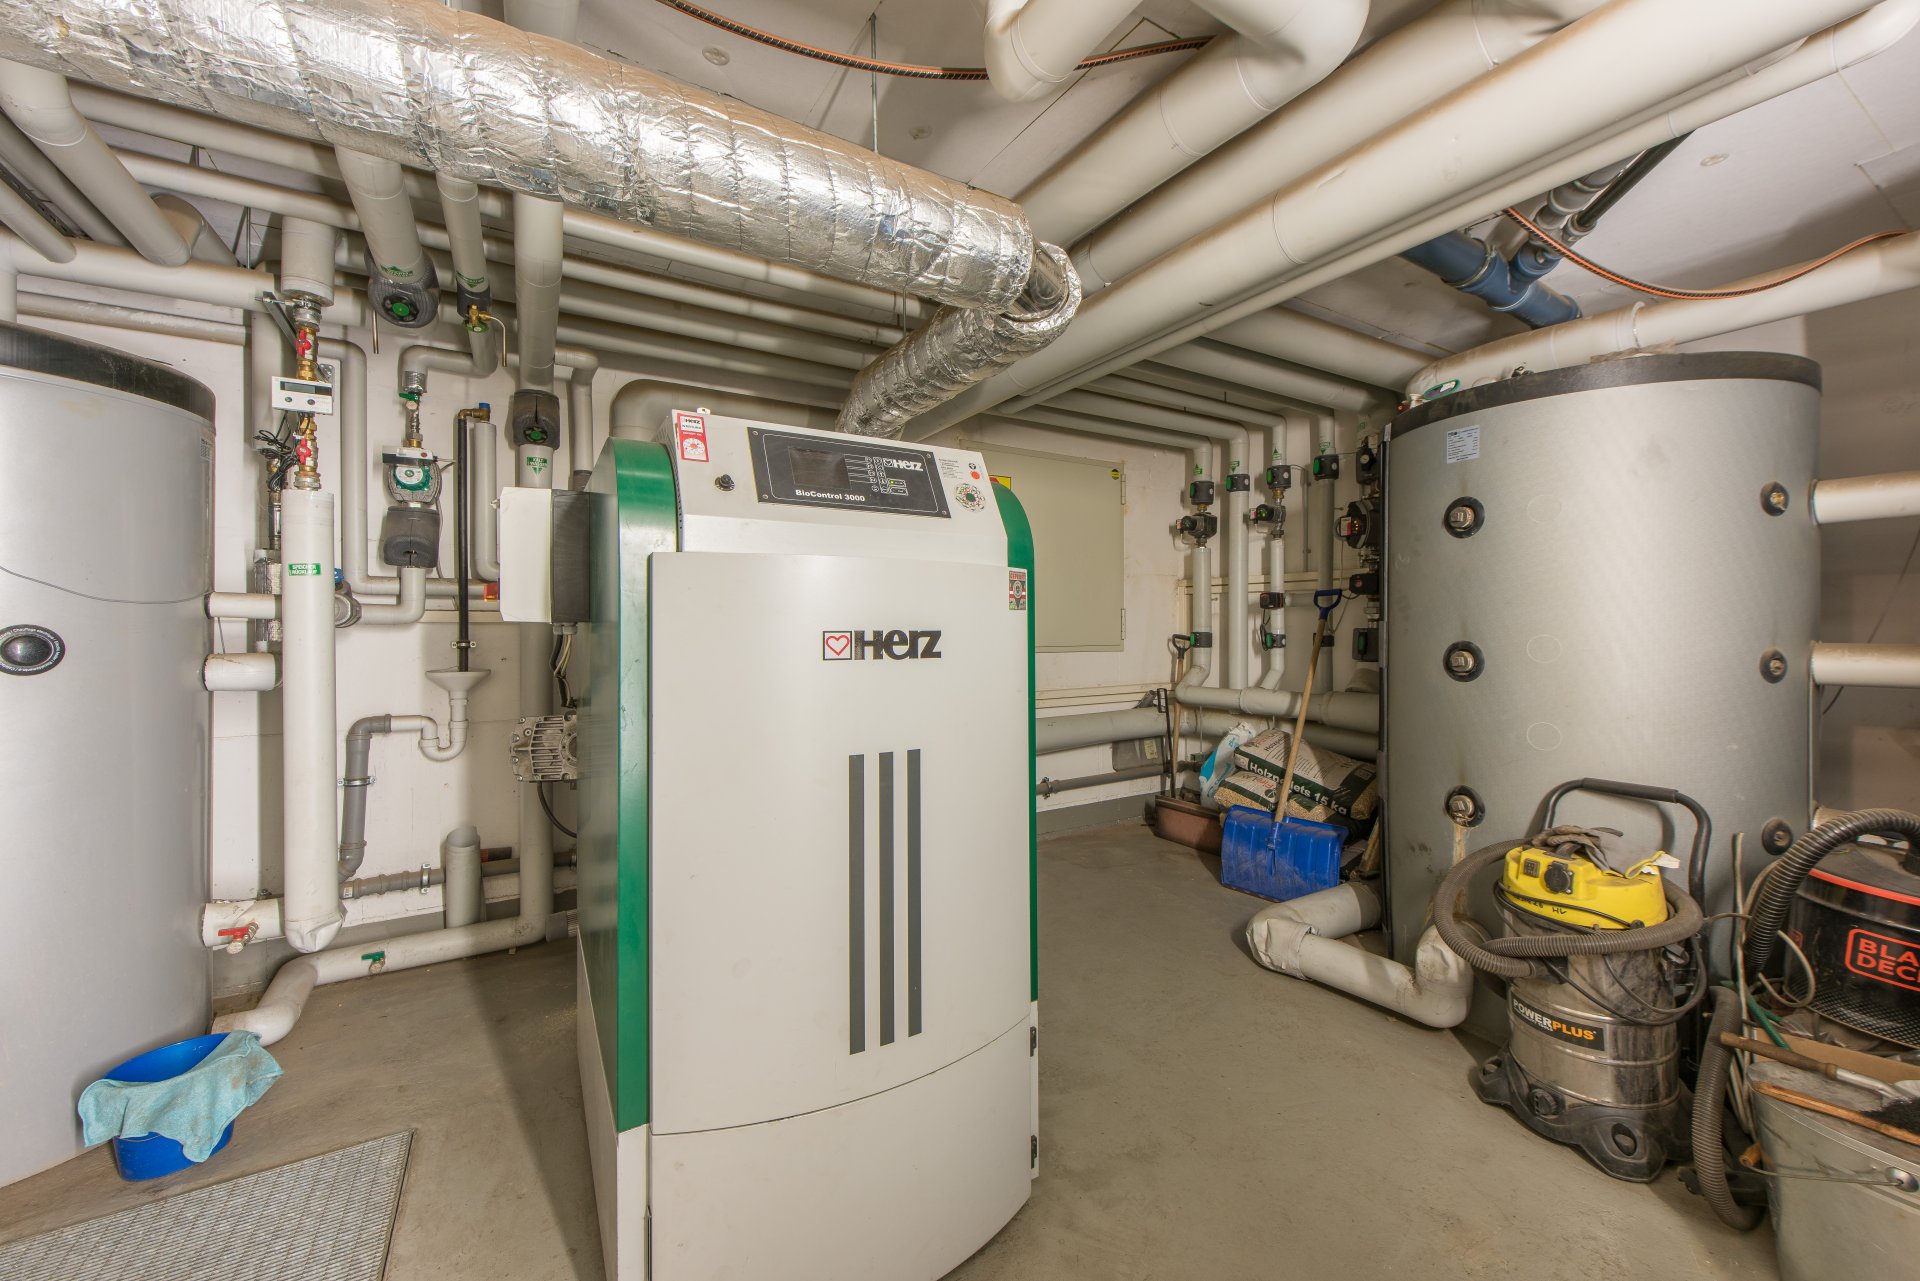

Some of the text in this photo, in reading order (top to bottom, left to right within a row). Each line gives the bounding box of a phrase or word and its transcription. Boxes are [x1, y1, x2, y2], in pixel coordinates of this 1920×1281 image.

[795, 489, 865, 502] BioControl 3000
[1249, 761, 1311, 798] Holzplets
[1313, 792, 1329, 806] 15
[1857, 953, 1920, 983] DEC
[1512, 998, 1595, 1041] POWERPLUS
